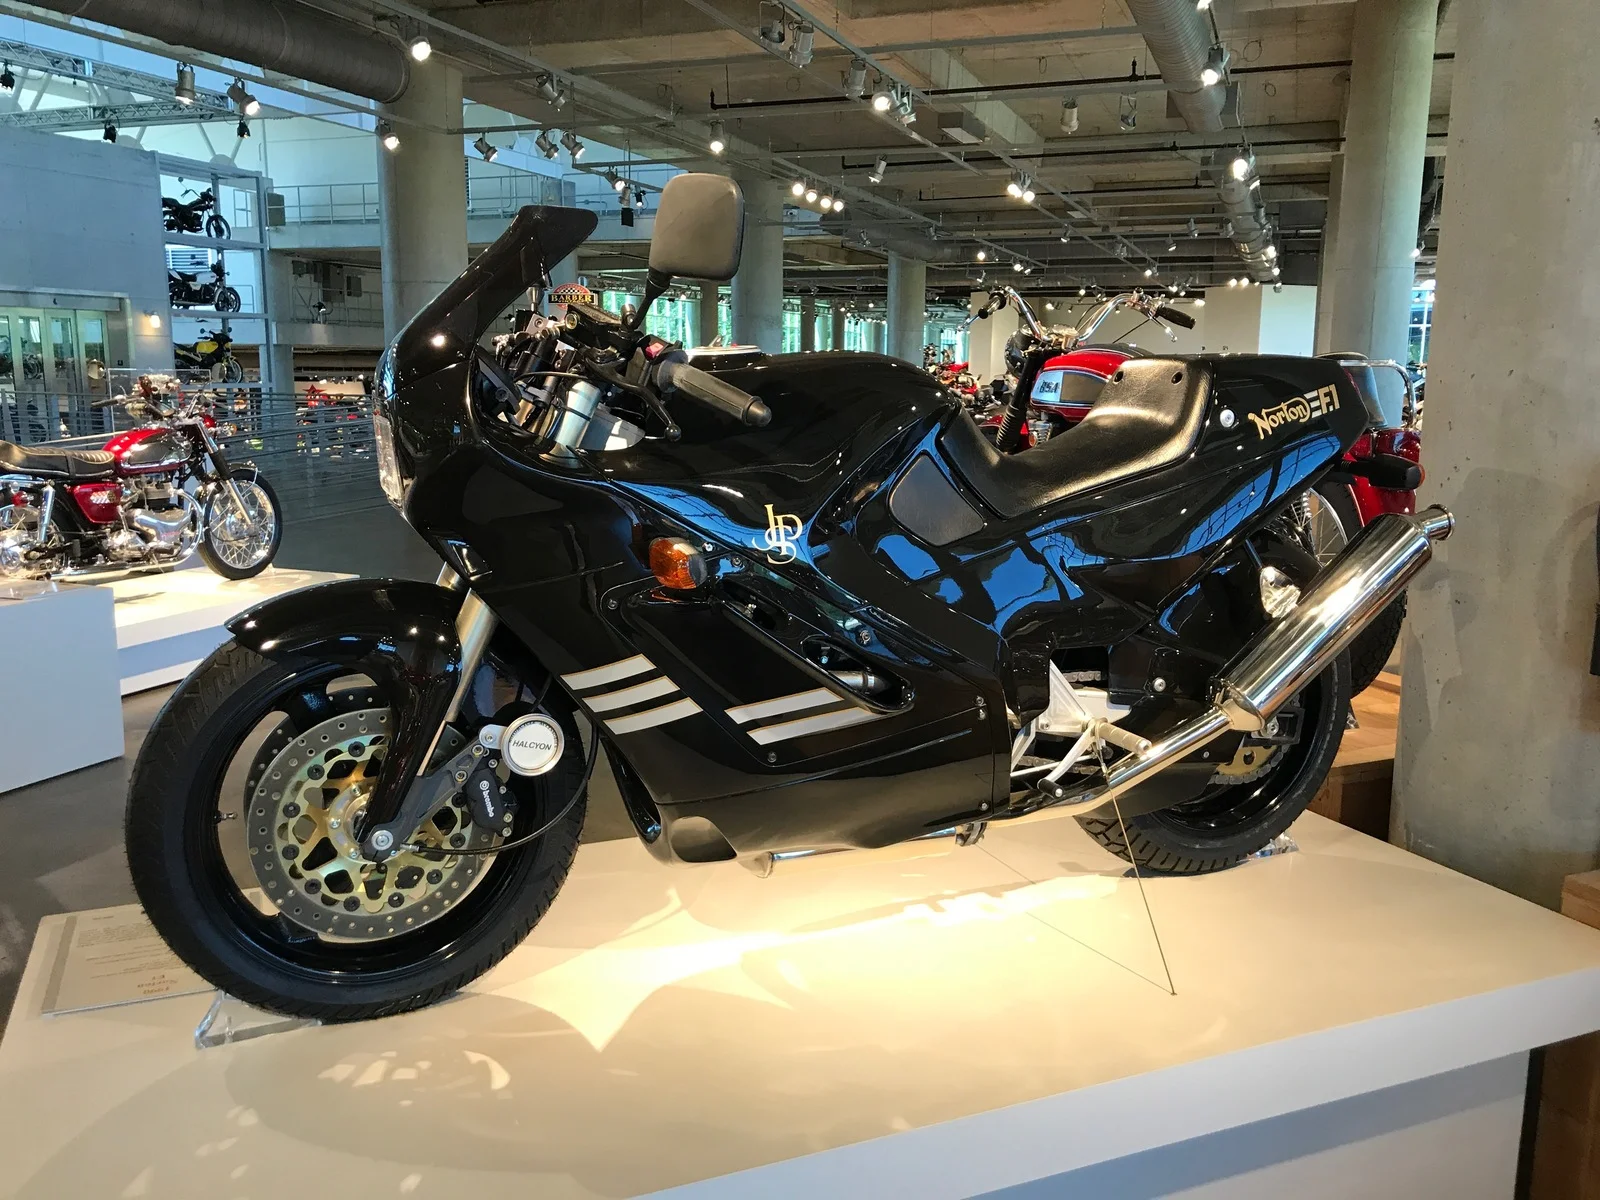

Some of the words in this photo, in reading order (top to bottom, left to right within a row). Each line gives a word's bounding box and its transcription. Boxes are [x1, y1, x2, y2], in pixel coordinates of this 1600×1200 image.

[551, 294, 592, 302] BARBER
[1039, 380, 1060, 393] BSA
[1247, 396, 1311, 440] Norton
[512, 740, 553, 751] HALCYON
[482, 789, 495, 818] brembo
